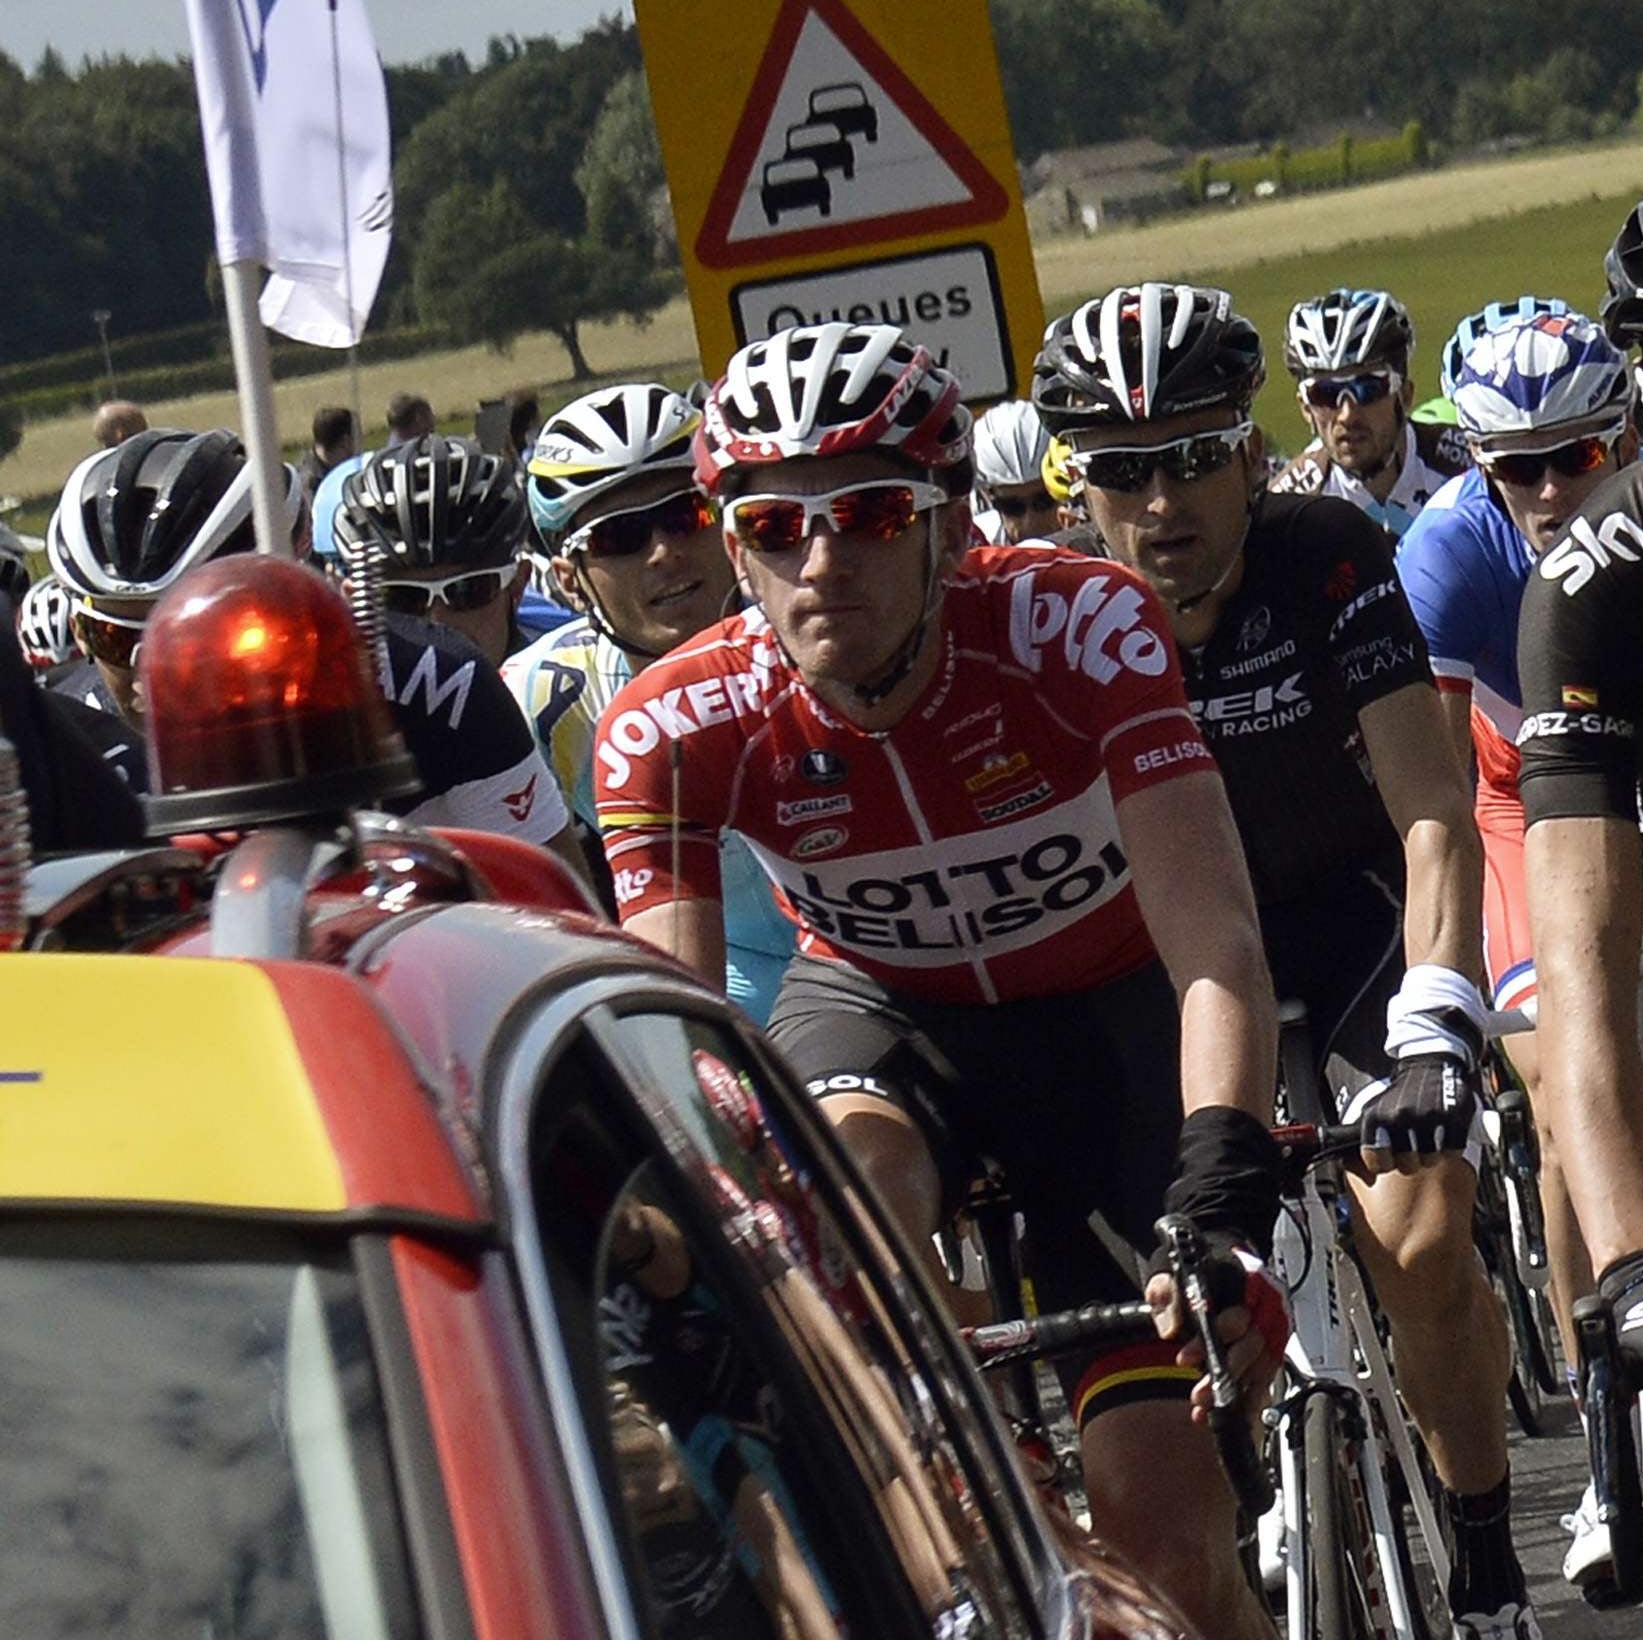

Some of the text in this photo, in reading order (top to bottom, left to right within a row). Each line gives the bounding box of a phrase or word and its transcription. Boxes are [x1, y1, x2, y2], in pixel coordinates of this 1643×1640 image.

[1220, 638, 1296, 681] SHIMANO
[1343, 643, 1416, 690] ALAXY
[1222, 699, 1313, 738] RACING
[804, 834, 1082, 914] LOTTO
